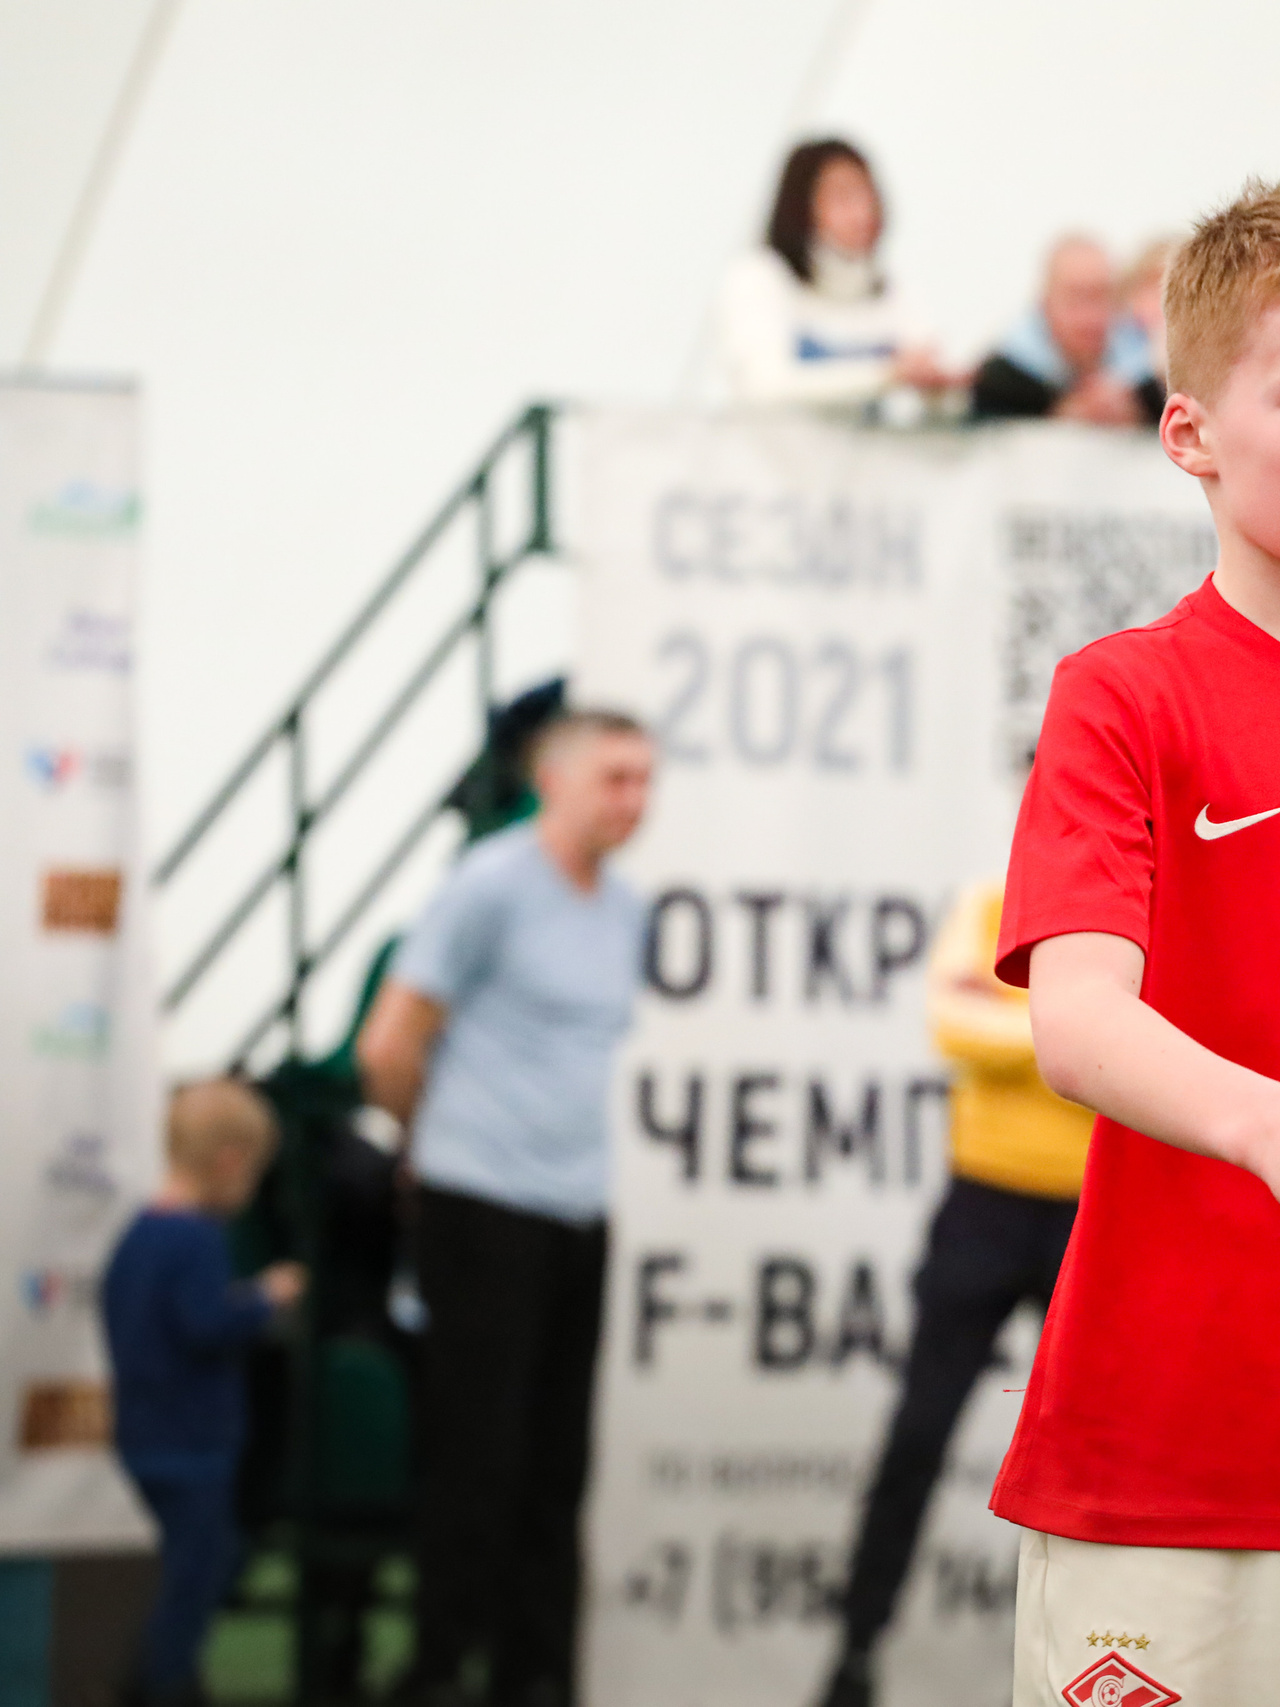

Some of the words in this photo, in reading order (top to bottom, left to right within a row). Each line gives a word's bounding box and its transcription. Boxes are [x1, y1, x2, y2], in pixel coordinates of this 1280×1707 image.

[655, 490, 924, 592] СЕЗОН
[655, 637, 915, 772] 2021
[645, 885, 930, 1012] ОТКР
[635, 1068, 952, 1186] ЧЕМП
[632, 1253, 912, 1368] F-BA
